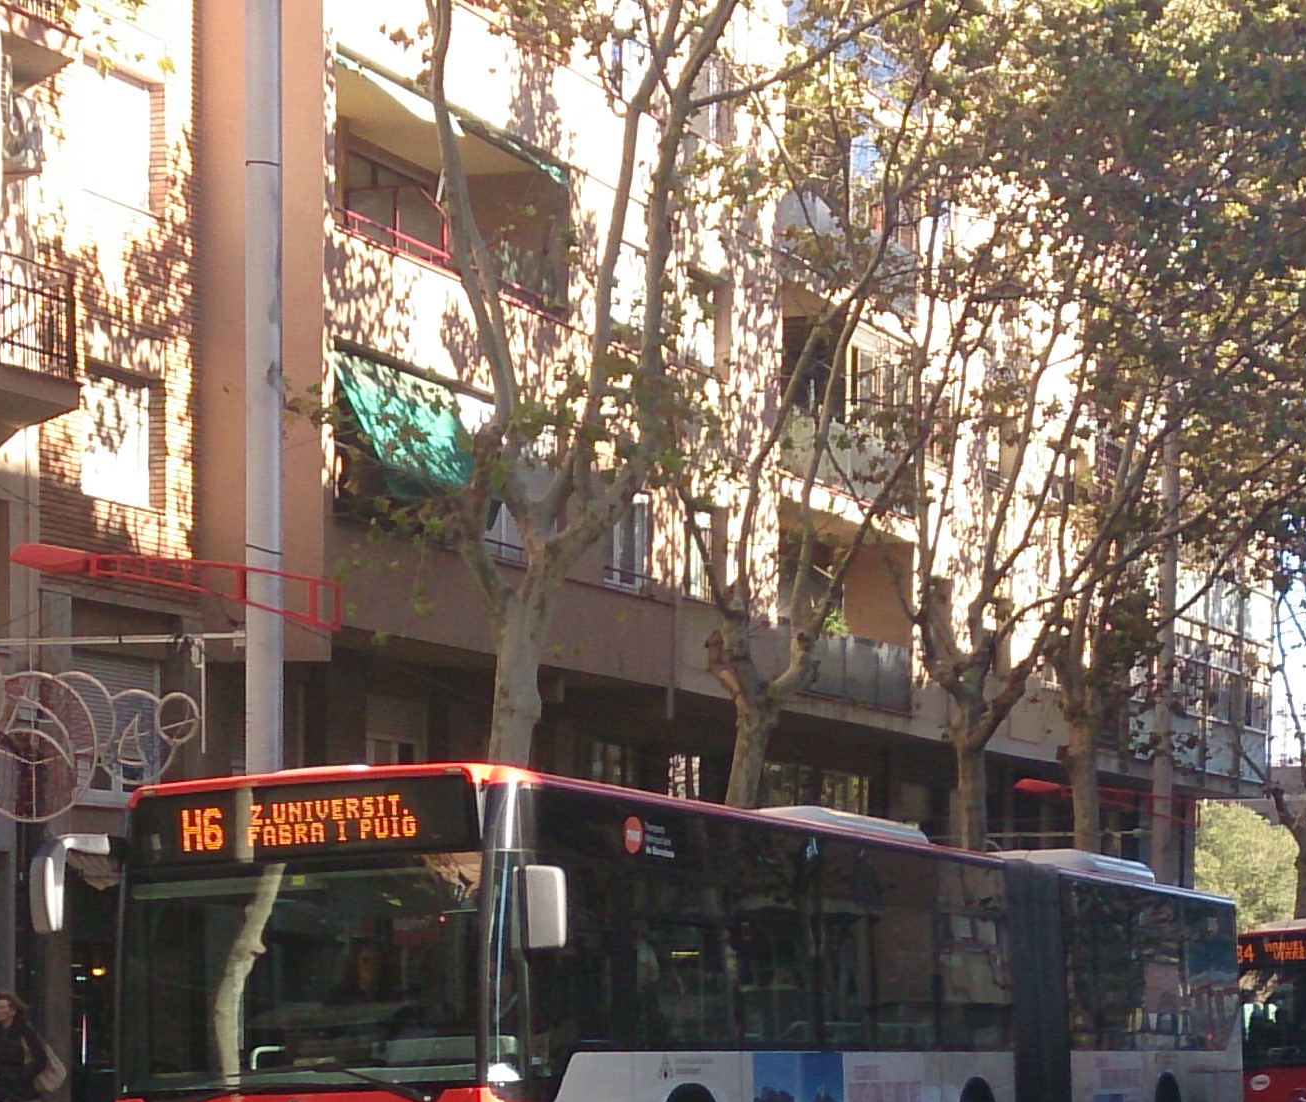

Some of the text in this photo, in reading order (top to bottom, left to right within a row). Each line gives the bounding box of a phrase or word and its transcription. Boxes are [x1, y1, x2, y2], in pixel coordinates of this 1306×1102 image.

[248, 794, 411, 825] Z.UNIVERSIT.
[180, 807, 225, 852] H6
[245, 814, 419, 847] FABRA I PUIG
